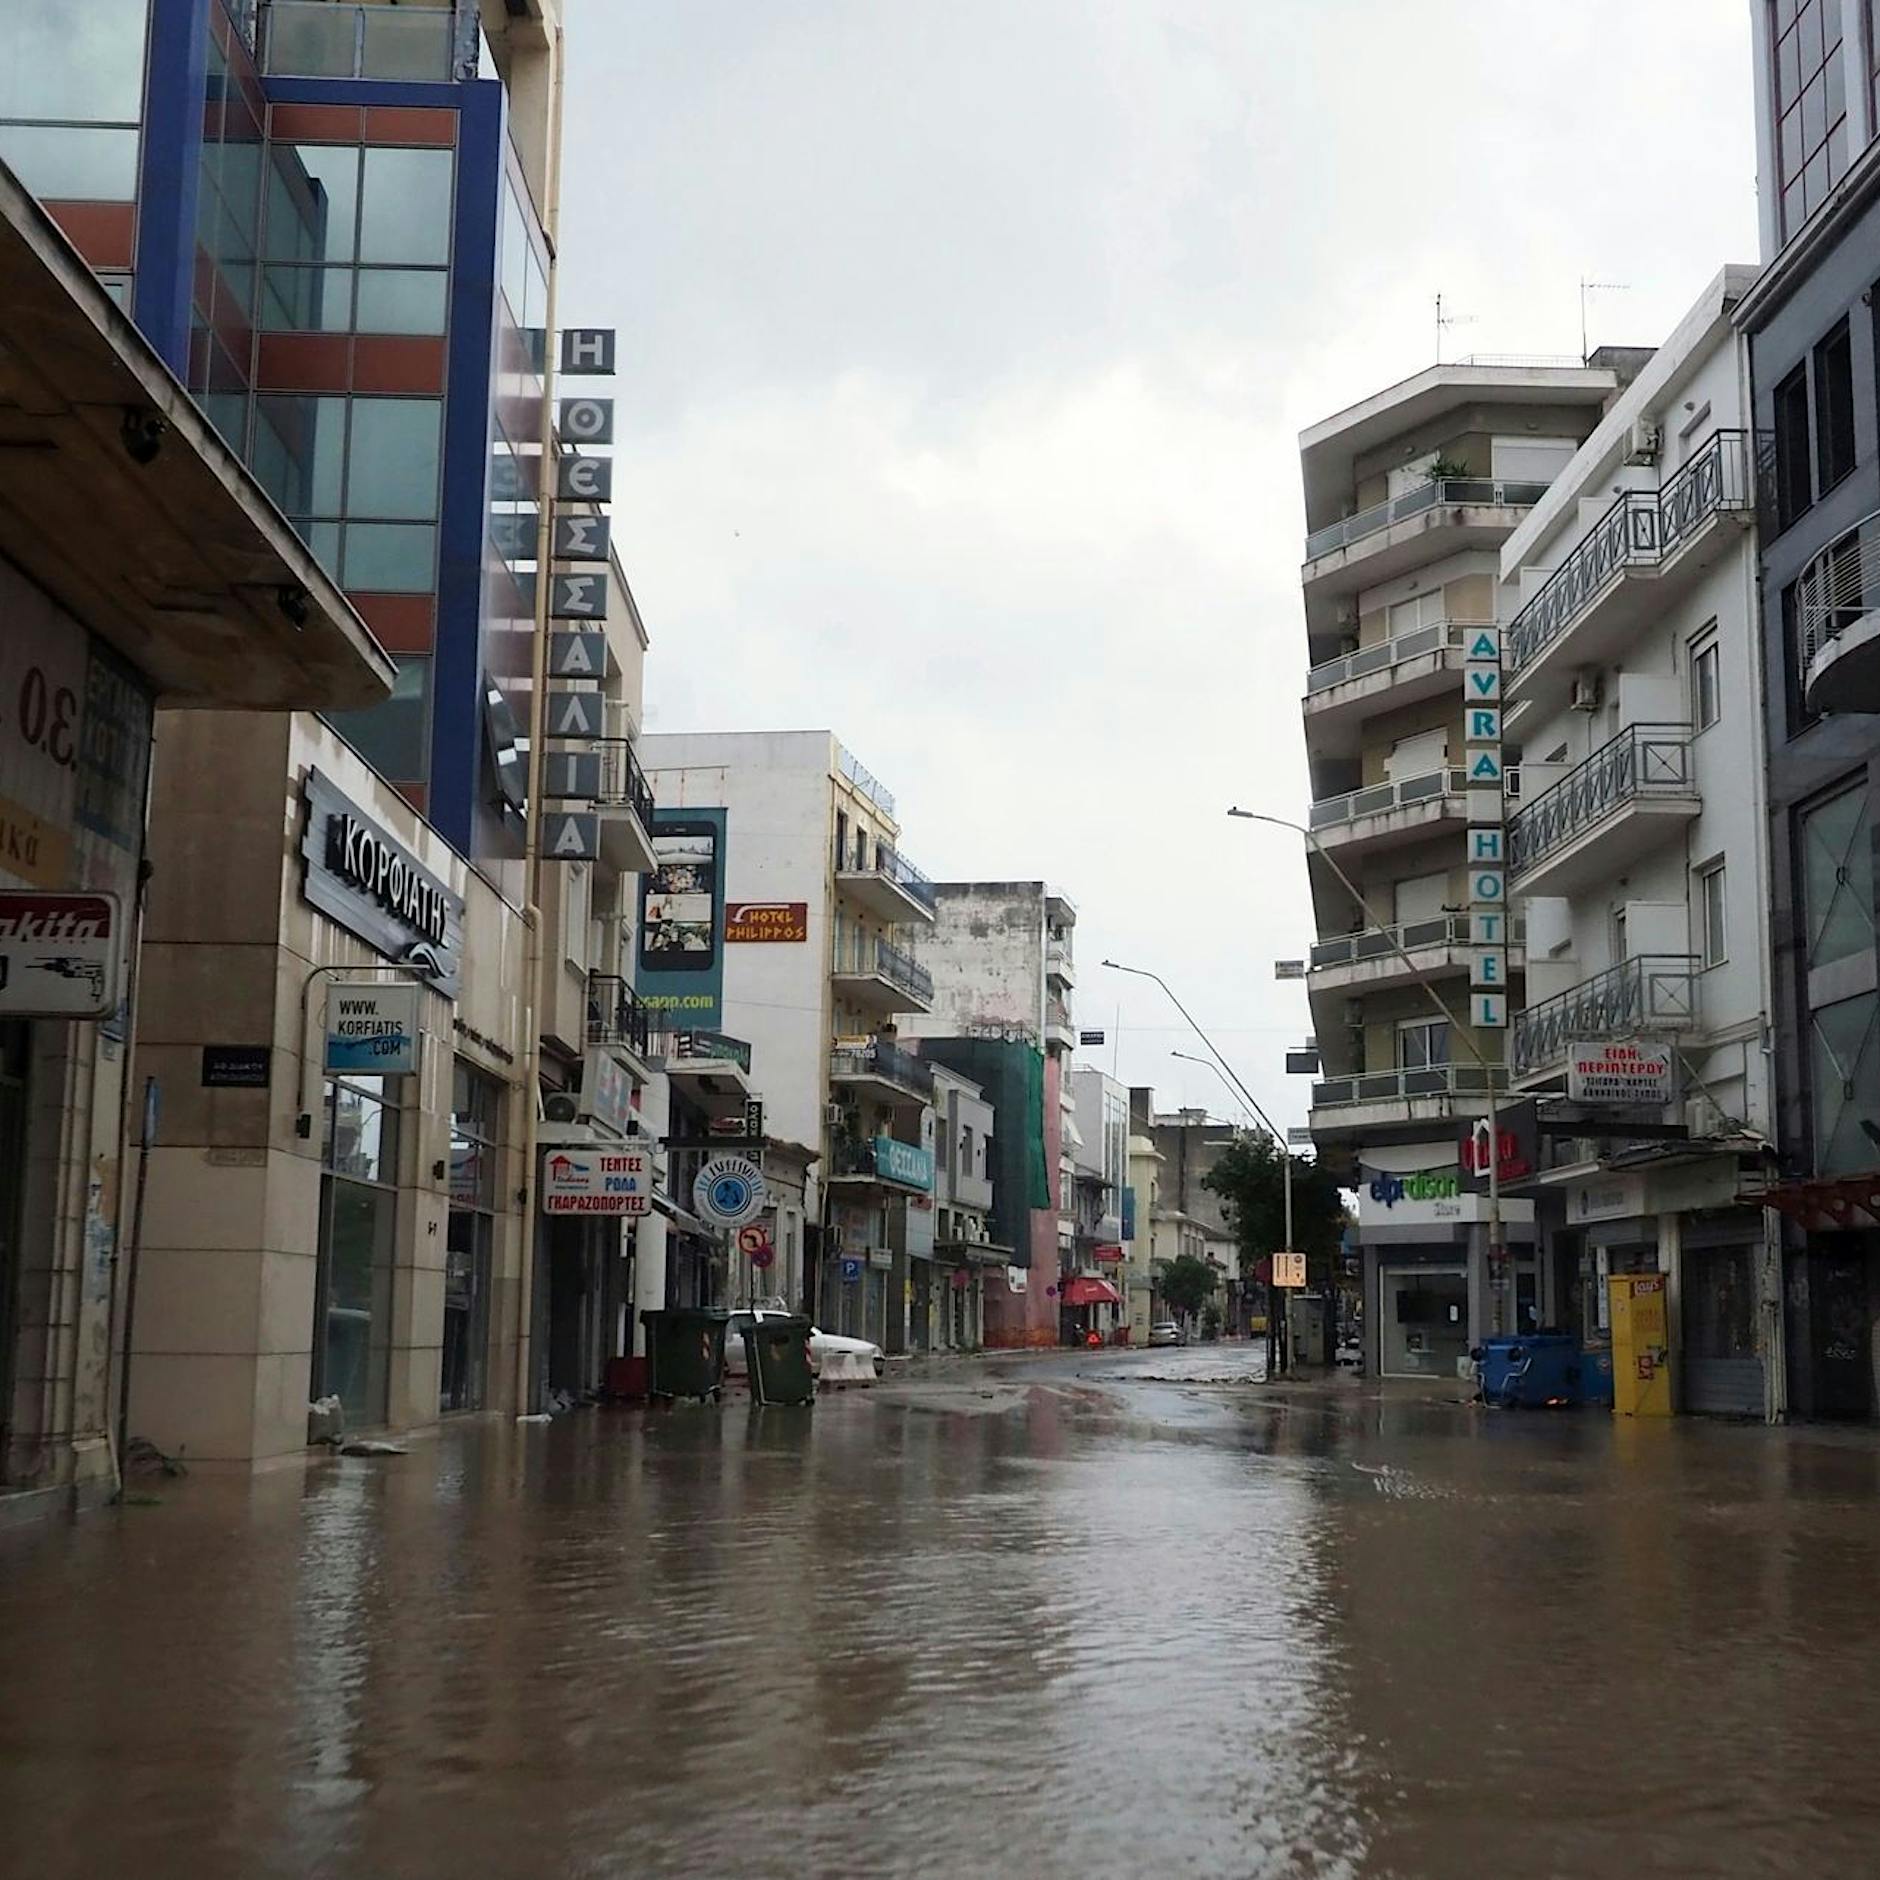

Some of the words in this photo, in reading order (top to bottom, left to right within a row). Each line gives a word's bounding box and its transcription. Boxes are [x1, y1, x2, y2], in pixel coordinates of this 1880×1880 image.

[1470, 632, 1499, 778] AVRA
[343, 814, 451, 950] ΚΟΡΦΙΑΤΗΣ
[749, 910, 794, 924] HOTEL
[726, 926, 804, 941] PHILIPPOS
[1475, 833, 1501, 1024] HOTEL
[339, 1000, 379, 1015] WWW.
[338, 1020, 404, 1035] KORFIATIS
[368, 1040, 401, 1056] .COM
[1604, 1047, 1637, 1060] ΕΙΔΗ
[1578, 1061, 1665, 1075] ΠΕΡΙΠΤΕΡΟΥ
[600, 1157, 643, 1173] ΤΕΝΤΕΣ
